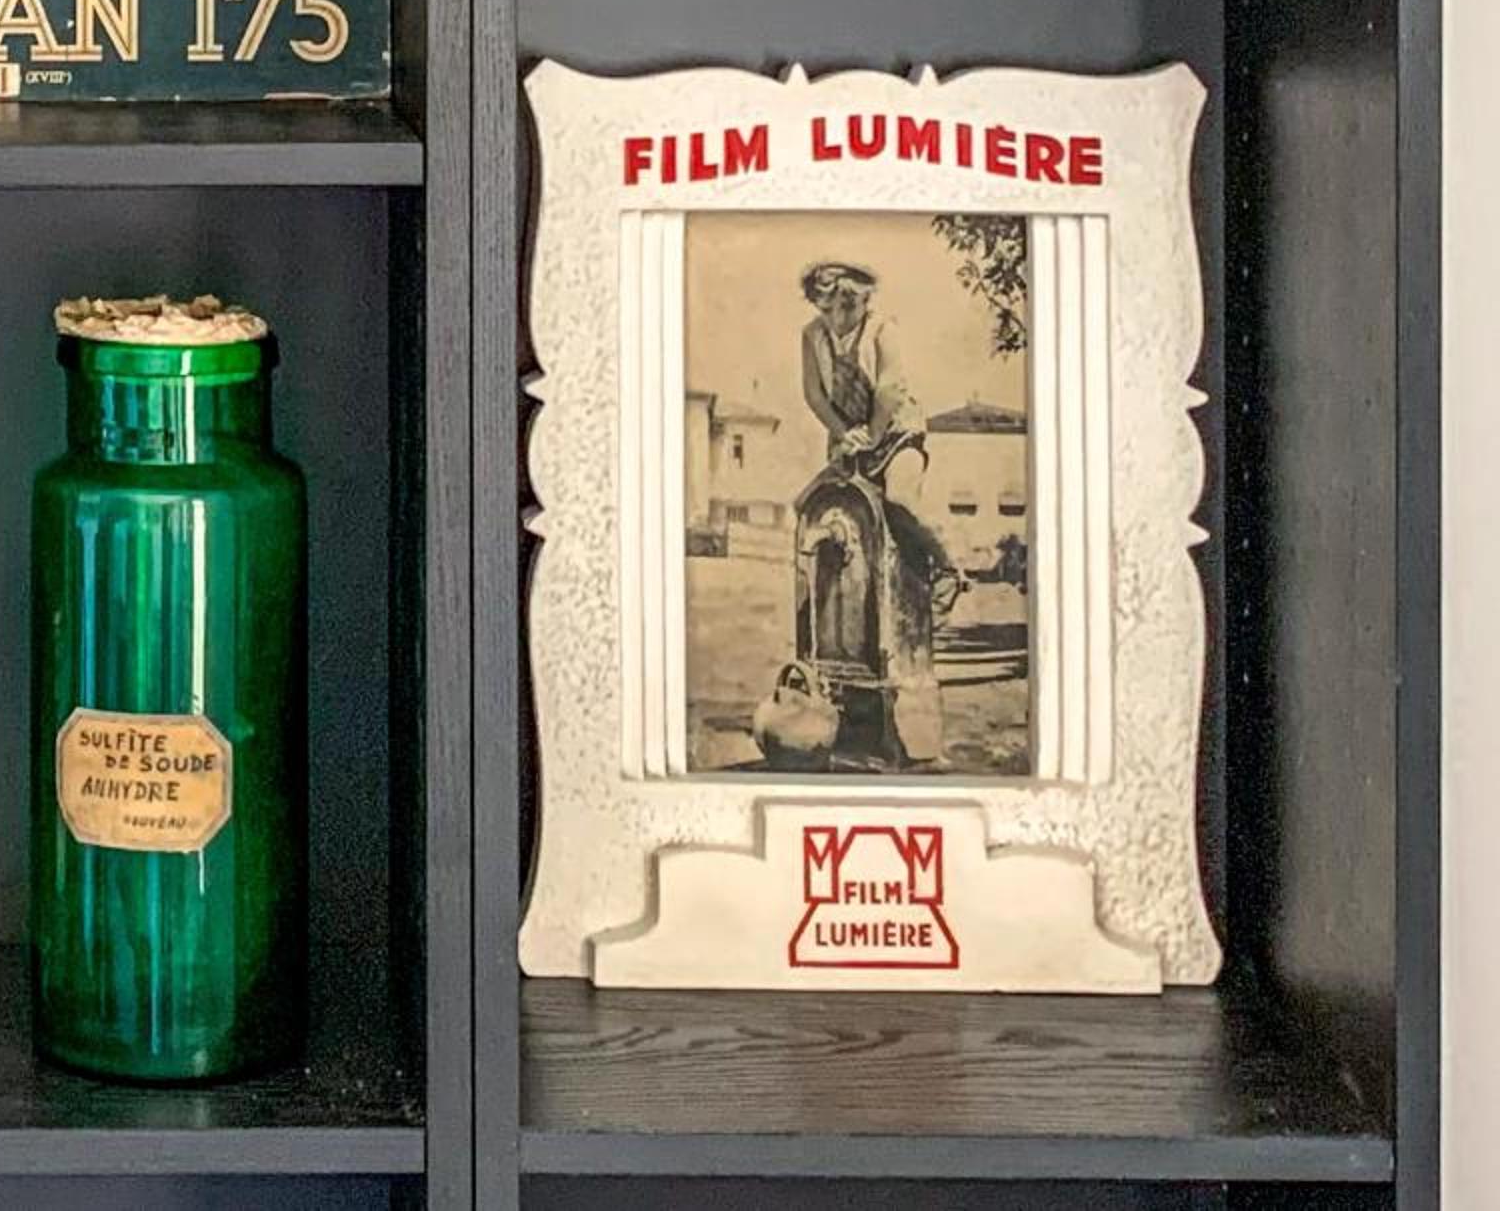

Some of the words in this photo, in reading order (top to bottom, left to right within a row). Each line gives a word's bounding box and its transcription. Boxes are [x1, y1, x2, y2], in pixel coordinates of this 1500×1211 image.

[623, 125, 769, 186] FILM
[811, 114, 1103, 186] LUMIÈRE
[140, 753, 217, 773] SOUDE
[81, 776, 181, 803] ANHYDRE
[844, 881, 903, 905] FILM
[815, 920, 933, 947] LUMIÈRE
